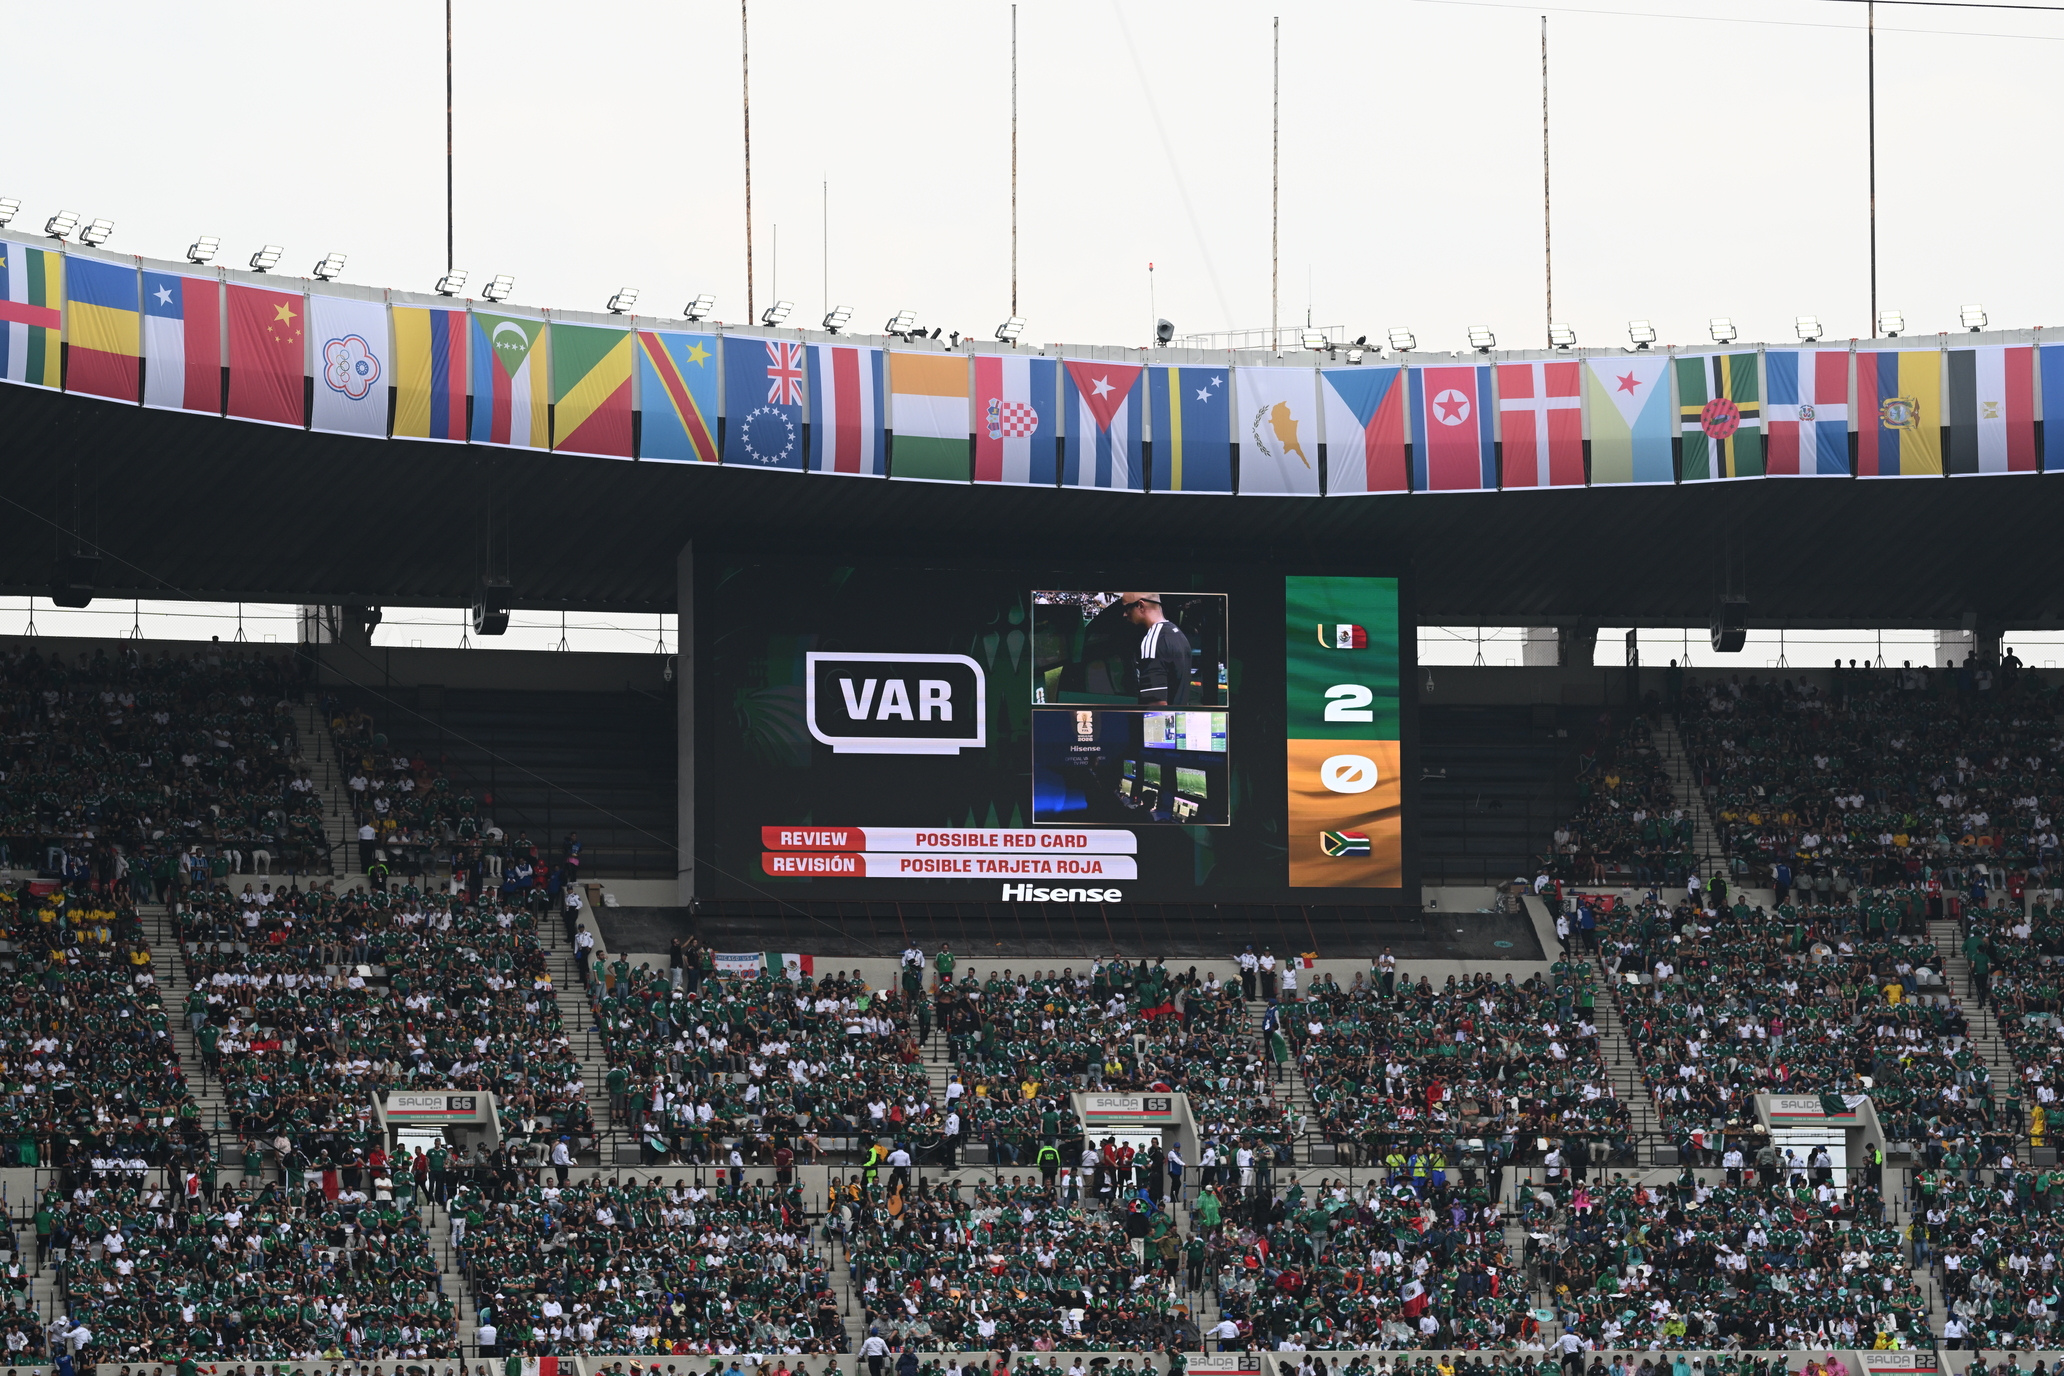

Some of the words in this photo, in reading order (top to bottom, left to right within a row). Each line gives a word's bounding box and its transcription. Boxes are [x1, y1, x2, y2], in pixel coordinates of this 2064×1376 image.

[839, 678, 953, 721] VAR
[1324, 684, 1373, 722] 2
[1321, 754, 1378, 793] 0
[781, 832, 848, 846] REVIEW
[916, 833, 999, 847] POSSIBLE
[1003, 834, 1036, 847] RED
[1041, 835, 1087, 848] CARD
[773, 855, 855, 872] REVISIÓN
[901, 858, 972, 872] POSIBLE
[976, 859, 1052, 873] TARJETA
[1057, 860, 1103, 874] ROJA
[1002, 884, 1122, 902] Hisense
[398, 1098, 442, 1106] SALIDA
[452, 1097, 471, 1110] 66
[1097, 1099, 1139, 1107] SALIDA
[1148, 1098, 1167, 1111] 65
[1781, 1101, 1822, 1109] SALIDA
[1190, 1357, 1233, 1366] SALIDA
[1239, 1358, 1259, 1370] 23
[1866, 1355, 1911, 1364] SALIDA
[1916, 1355, 1936, 1368] 22
